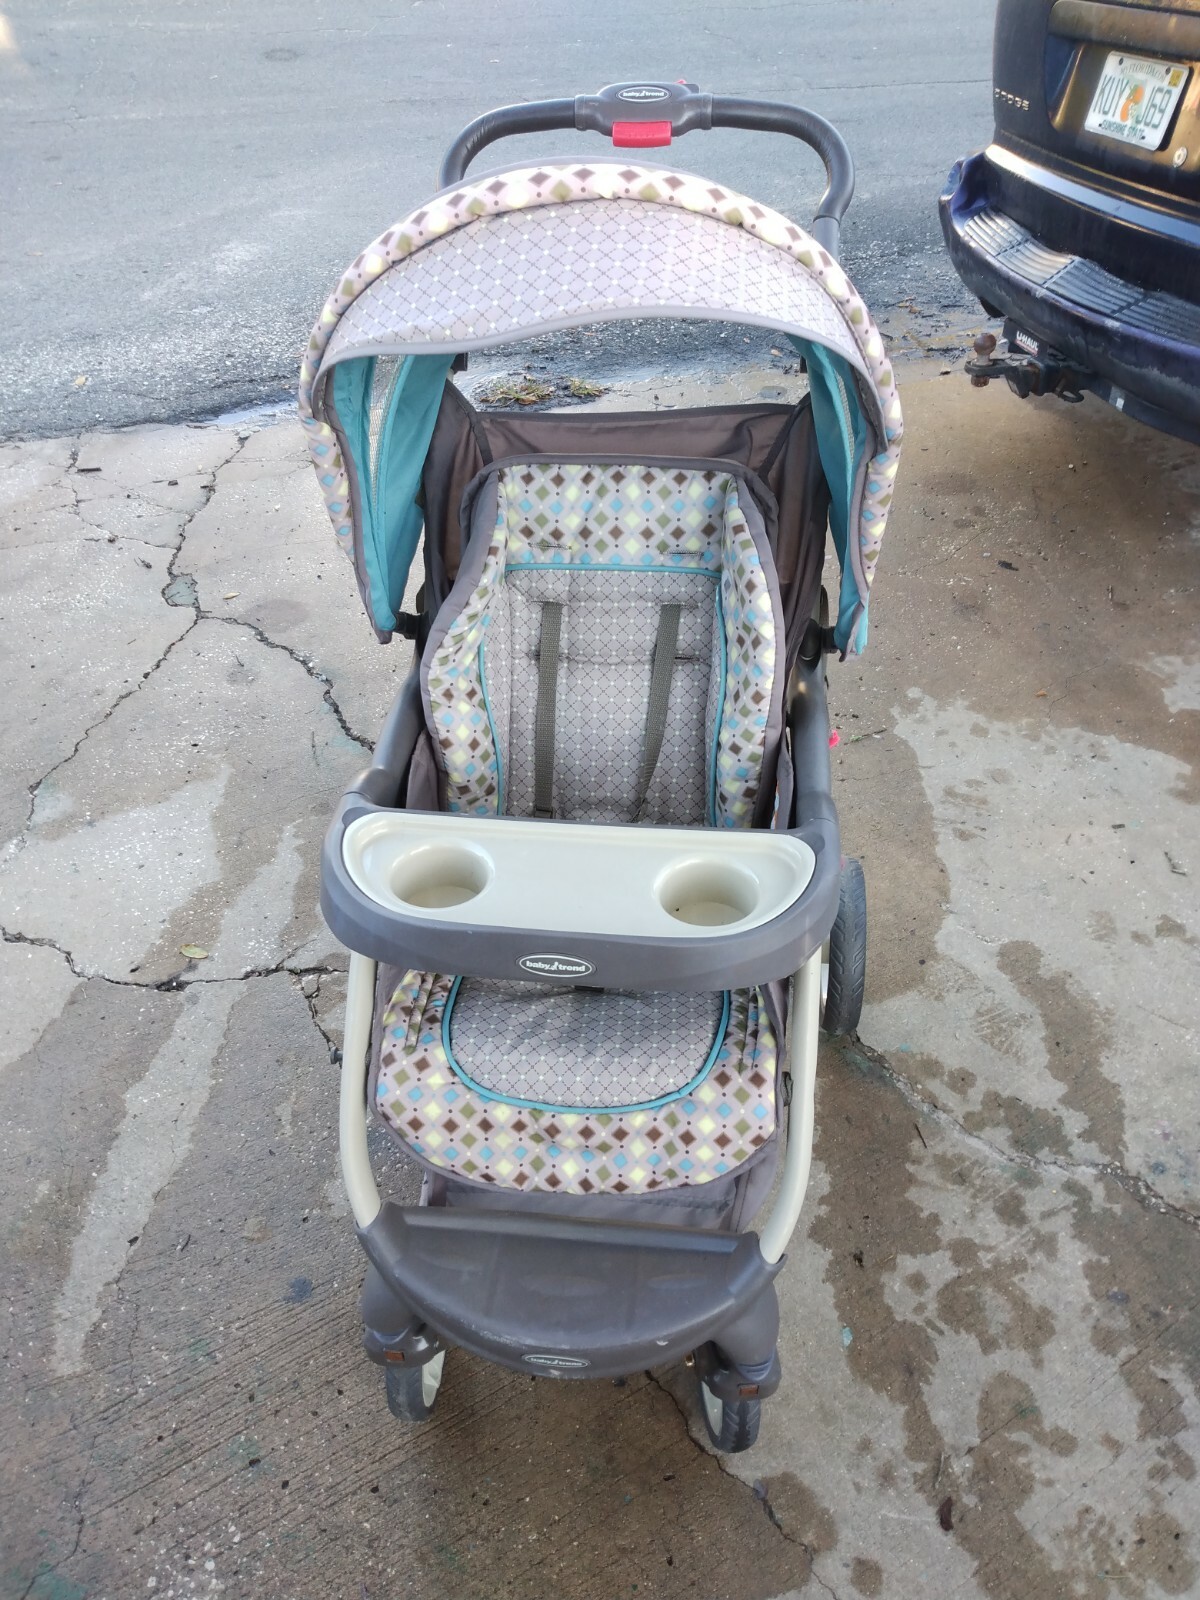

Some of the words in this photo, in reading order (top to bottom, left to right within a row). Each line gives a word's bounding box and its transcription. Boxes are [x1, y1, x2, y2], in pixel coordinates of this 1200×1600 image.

[1093, 74, 1130, 118] KUY
[1135, 86, 1172, 129] J69
[1101, 119, 1127, 136] SUNSHINE
[1126, 126, 1145, 139] STATE
[526, 960, 550, 970] baby
[558, 964, 586, 972] trend
